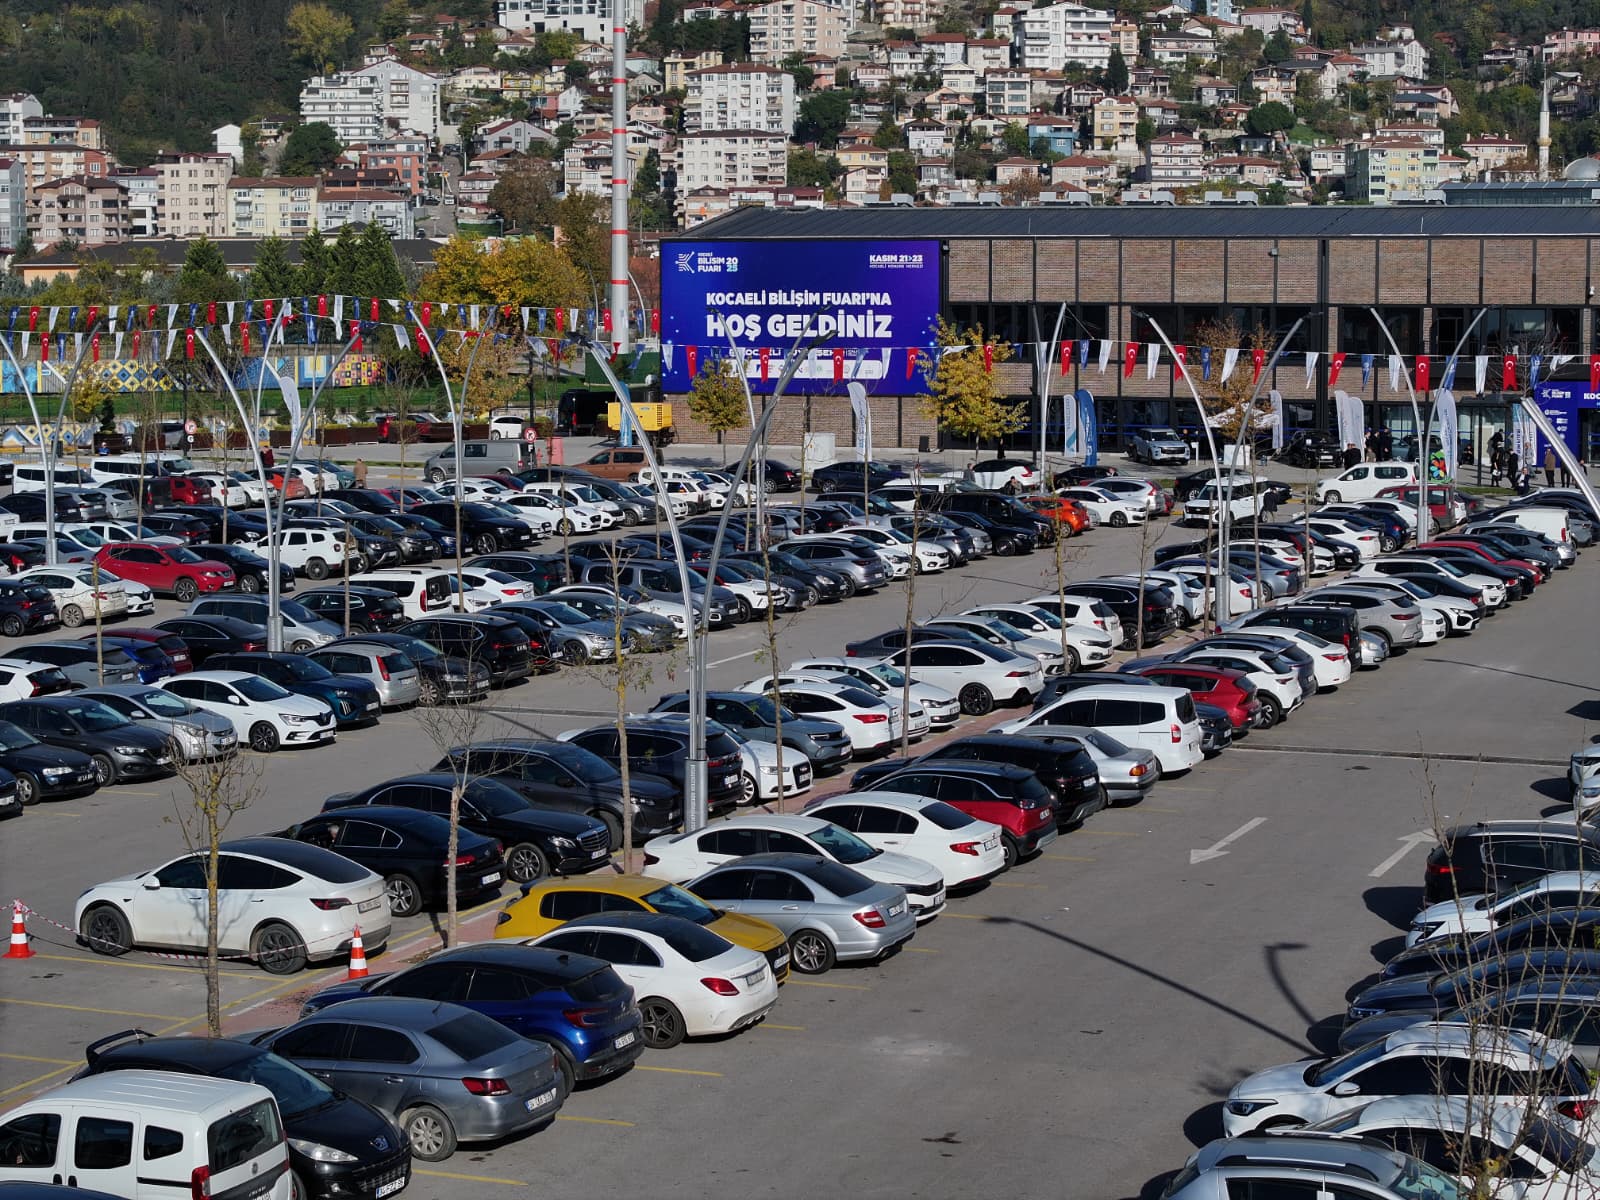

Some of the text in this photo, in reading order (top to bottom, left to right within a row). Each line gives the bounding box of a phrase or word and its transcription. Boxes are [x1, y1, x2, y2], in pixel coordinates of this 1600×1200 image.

[869, 254, 898, 262] KASIM
[726, 264, 738, 272] 25
[706, 290, 765, 305] KOCAELİ
[768, 290, 820, 306] BİLİŞİM
[707, 309, 892, 341] HOŞ GELDİNİZ
